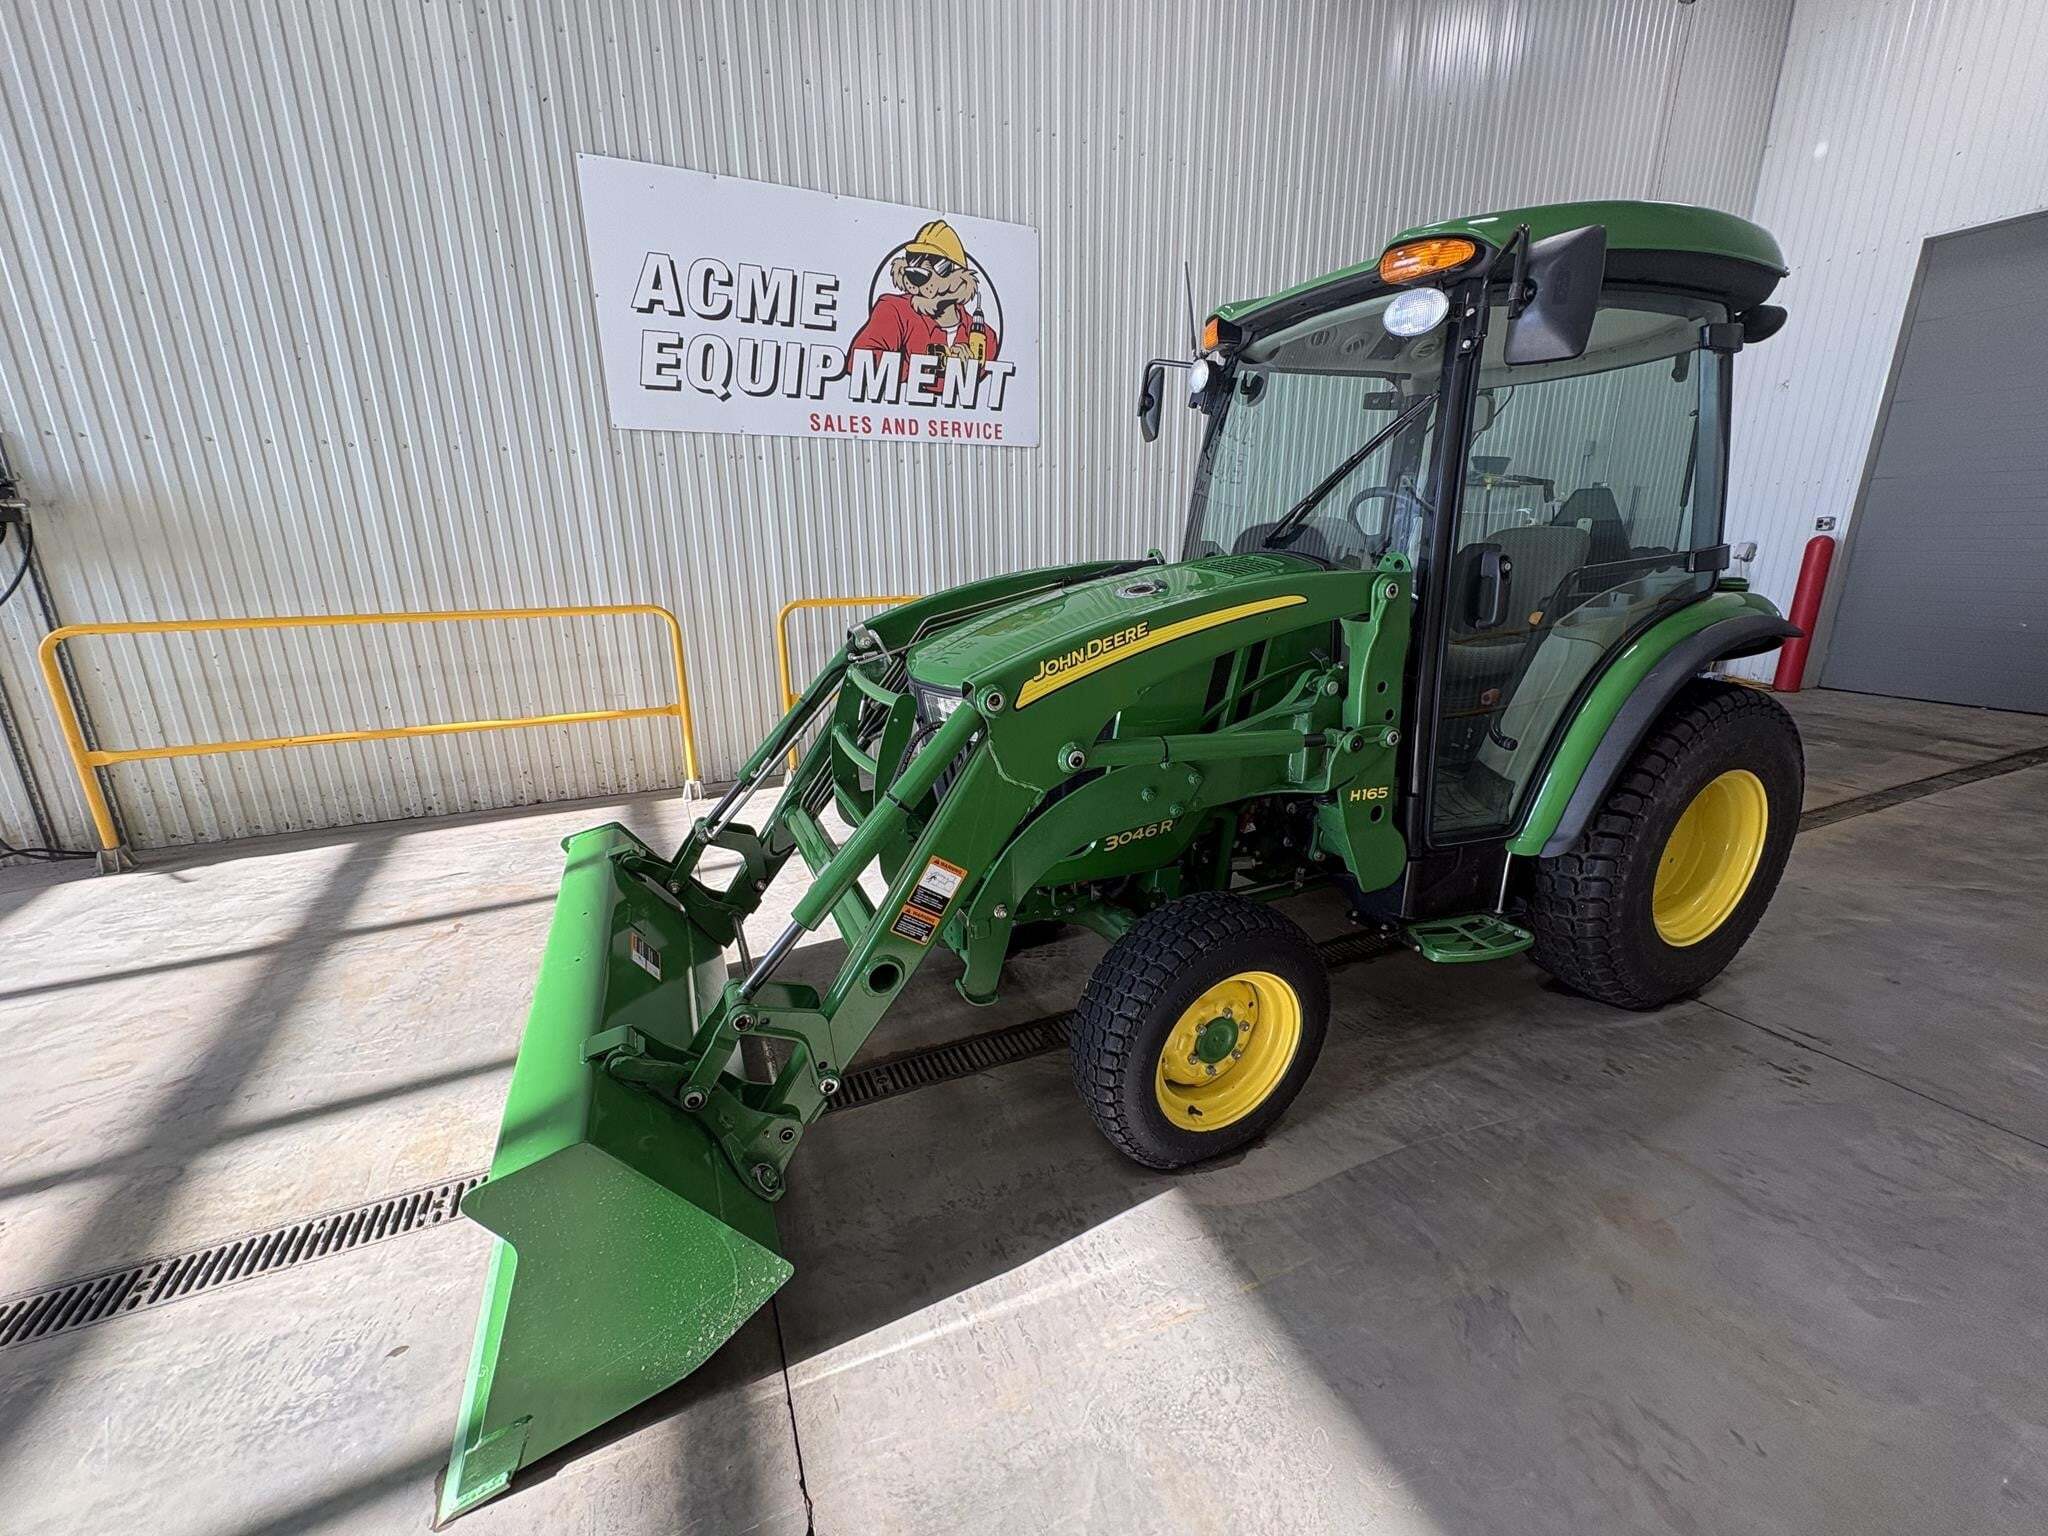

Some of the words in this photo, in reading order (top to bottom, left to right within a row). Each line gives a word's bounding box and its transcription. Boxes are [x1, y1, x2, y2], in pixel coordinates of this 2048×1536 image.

[631, 252, 839, 331] ACME
[640, 329, 1016, 411] EQUIPMENT
[810, 413, 872, 434] SALES
[882, 417, 919, 437] AND
[928, 420, 1003, 440] SERVICE
[1033, 648, 1084, 681] JOHN
[1086, 622, 1148, 658] DEERE
[1350, 786, 1388, 802] H165
